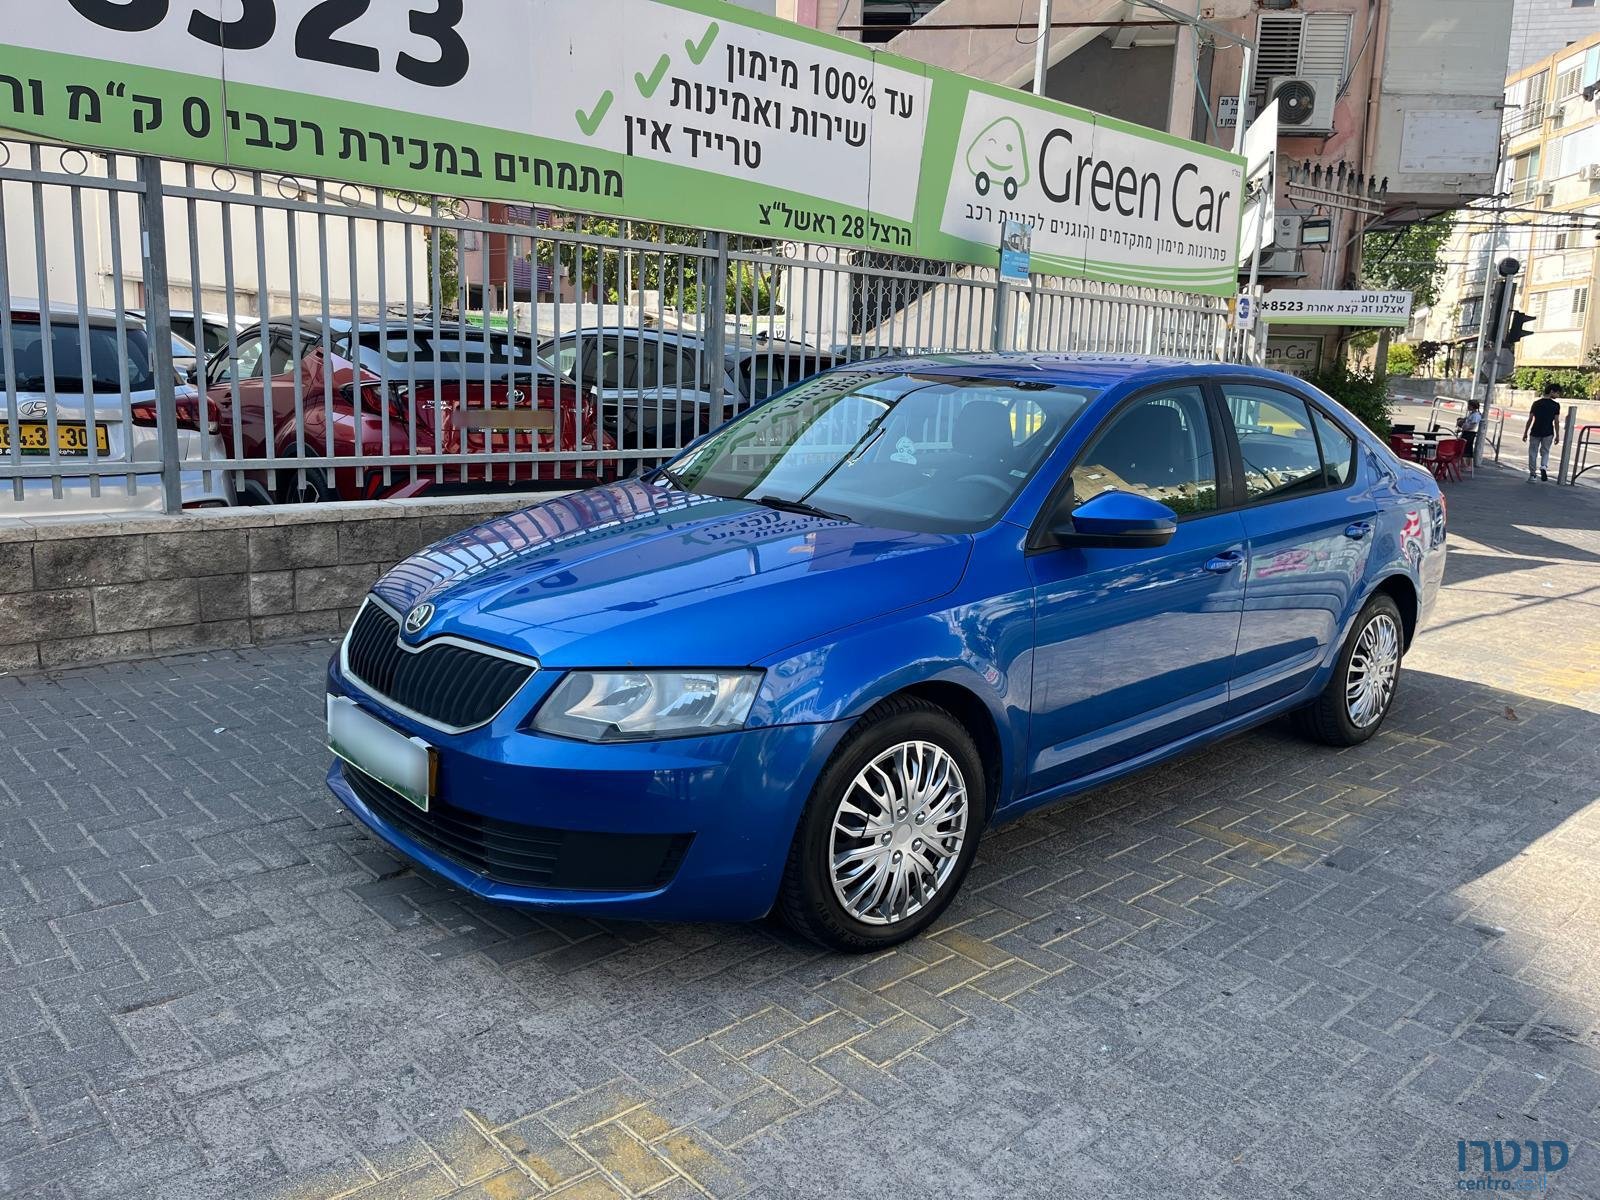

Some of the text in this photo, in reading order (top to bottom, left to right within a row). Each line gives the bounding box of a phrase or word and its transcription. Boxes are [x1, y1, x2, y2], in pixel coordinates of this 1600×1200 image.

[66, 0, 469, 87] 23
[726, 44, 914, 119] עד 100% מימון
[182, 96, 211, 139] 0
[670, 77, 867, 148] שירות ואמינות
[226, 109, 325, 156] רכבי
[624, 115, 762, 169] טרייד אין
[338, 127, 483, 179] במכירת
[494, 151, 623, 198] מתמחים
[1039, 128, 1231, 234] Green Car
[965, 203, 992, 223] רכב
[841, 213, 865, 239] 28
[869, 217, 911, 247] הרצל
[1050, 219, 1095, 240] והוגנים
[1100, 228, 1152, 250] מתקדמים
[1156, 237, 1184, 255] מימון
[1187, 243, 1227, 261] פתרונות
[1306, 303, 1334, 312] אחרת
[1336, 304, 1358, 315] קצת
[1361, 305, 1373, 313] זה
[1375, 303, 1404, 314] אצלנו
[1382, 294, 1406, 304] שלם
[1285, 344, 1313, 360] Car
